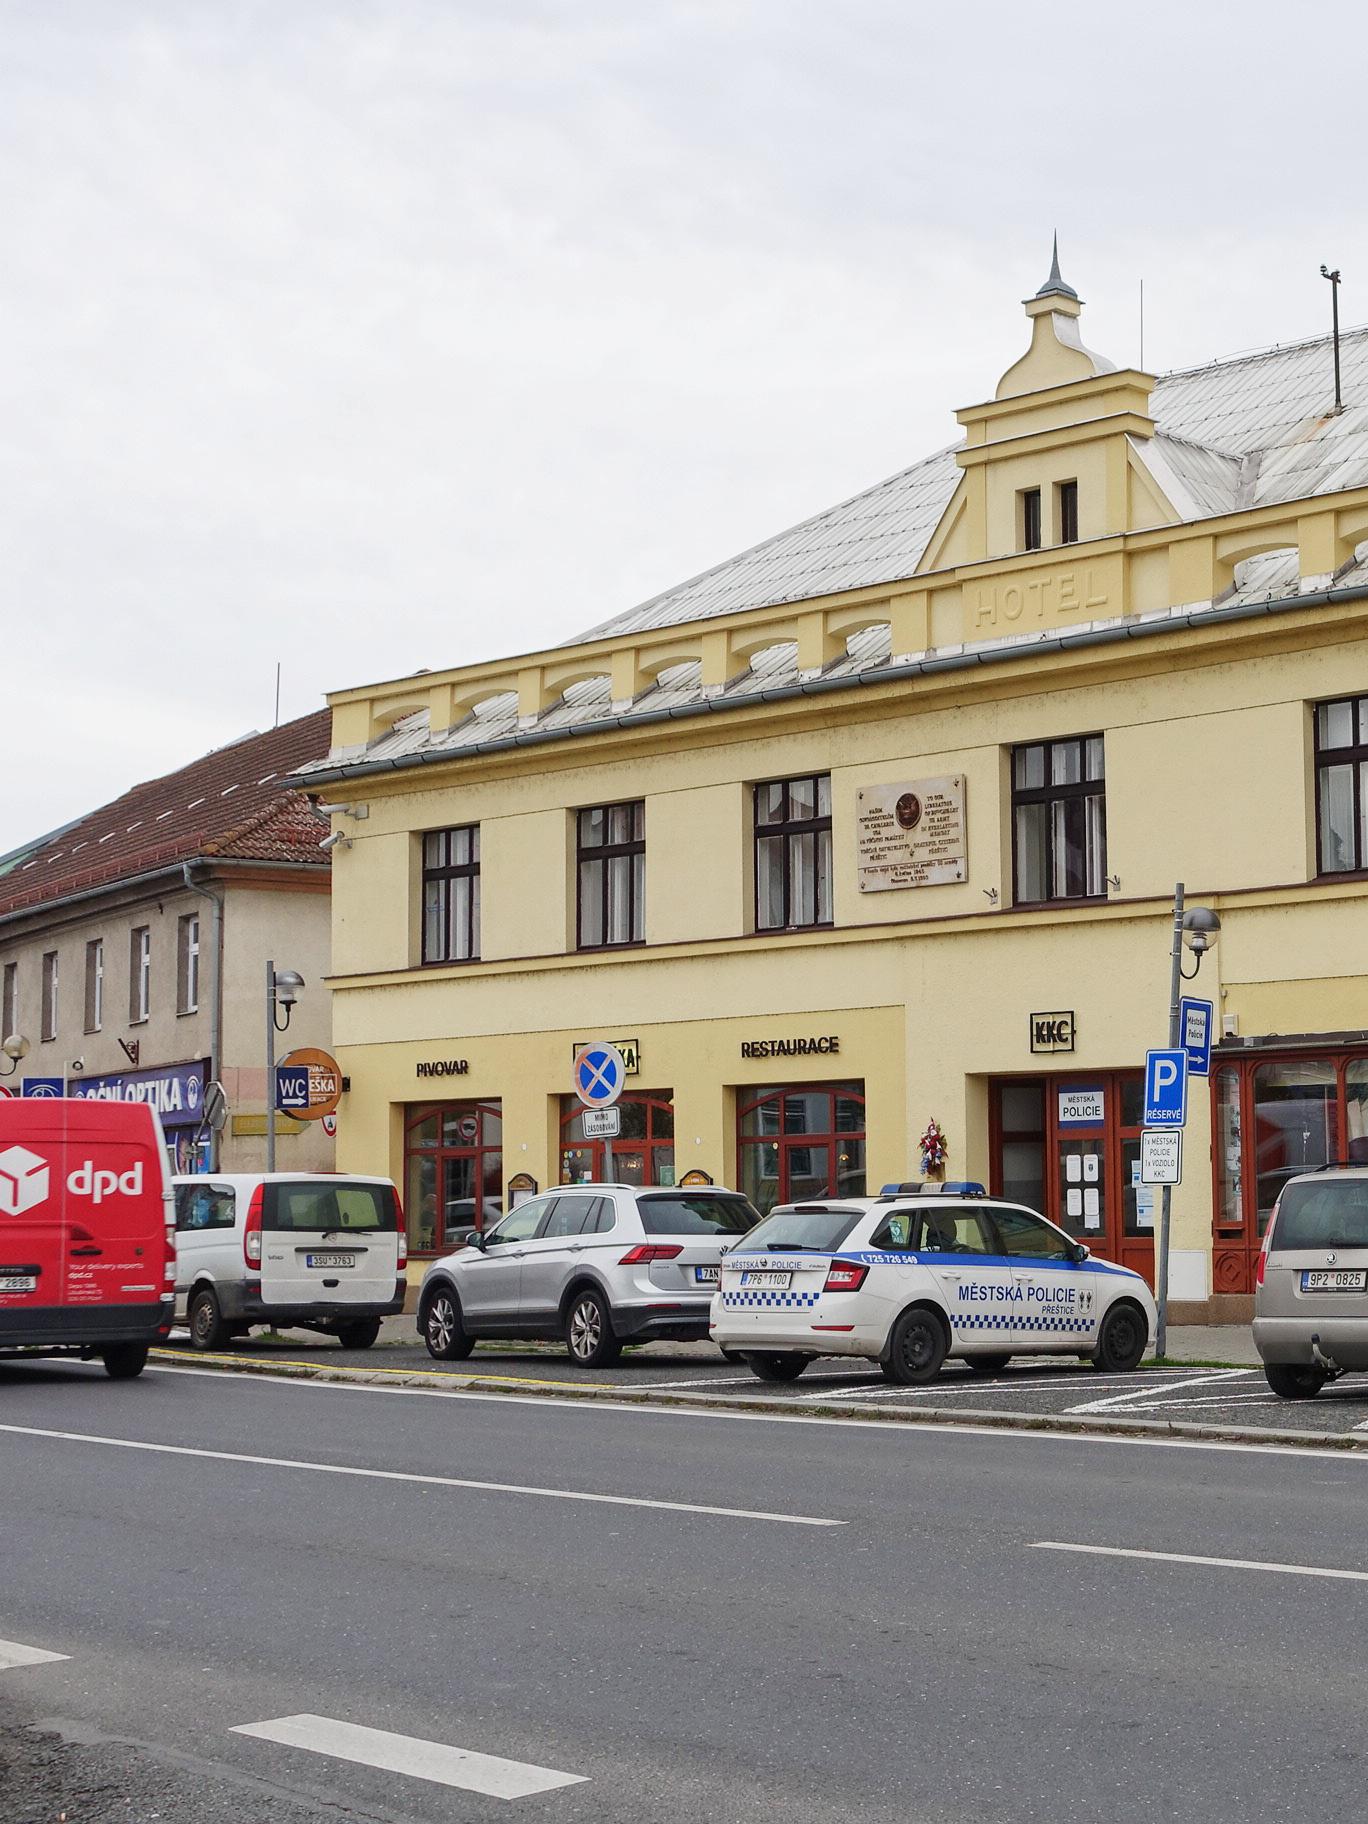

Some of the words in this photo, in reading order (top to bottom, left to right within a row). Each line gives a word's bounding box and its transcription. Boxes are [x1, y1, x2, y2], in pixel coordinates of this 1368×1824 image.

[976, 570, 1108, 627] HOTEL
[1036, 1020, 1069, 1043] KKC
[741, 1036, 840, 1058] RESTAURACE
[416, 1060, 469, 1077] PIVOVAR
[1153, 1059, 1177, 1102] P
[279, 1079, 306, 1097] WC
[1068, 1094, 1095, 1103] MĚSTSKÁ
[1063, 1106, 1101, 1117] POLICIE
[1147, 1108, 1181, 1119] RÉSERVÉ
[1151, 1136, 1177, 1145] MĚSTSKÁ
[1150, 1148, 1170, 1156] POLICIE
[66, 1160, 143, 1204] dpd
[332, 1256, 352, 1265] 3763
[772, 1261, 802, 1269] POLICIE
[867, 1255, 884, 1263] 725
[902, 1256, 918, 1264] 549
[748, 1274, 762, 1284] 7P6
[769, 1274, 787, 1284] 1100
[1310, 1274, 1328, 1286] 9P2
[1336, 1274, 1361, 1285] 0825
[959, 1282, 1023, 1301] MĚSTSKÁ
[1027, 1287, 1076, 1302] POLICIE
[1041, 1305, 1074, 1315] PŘEŠTICE
